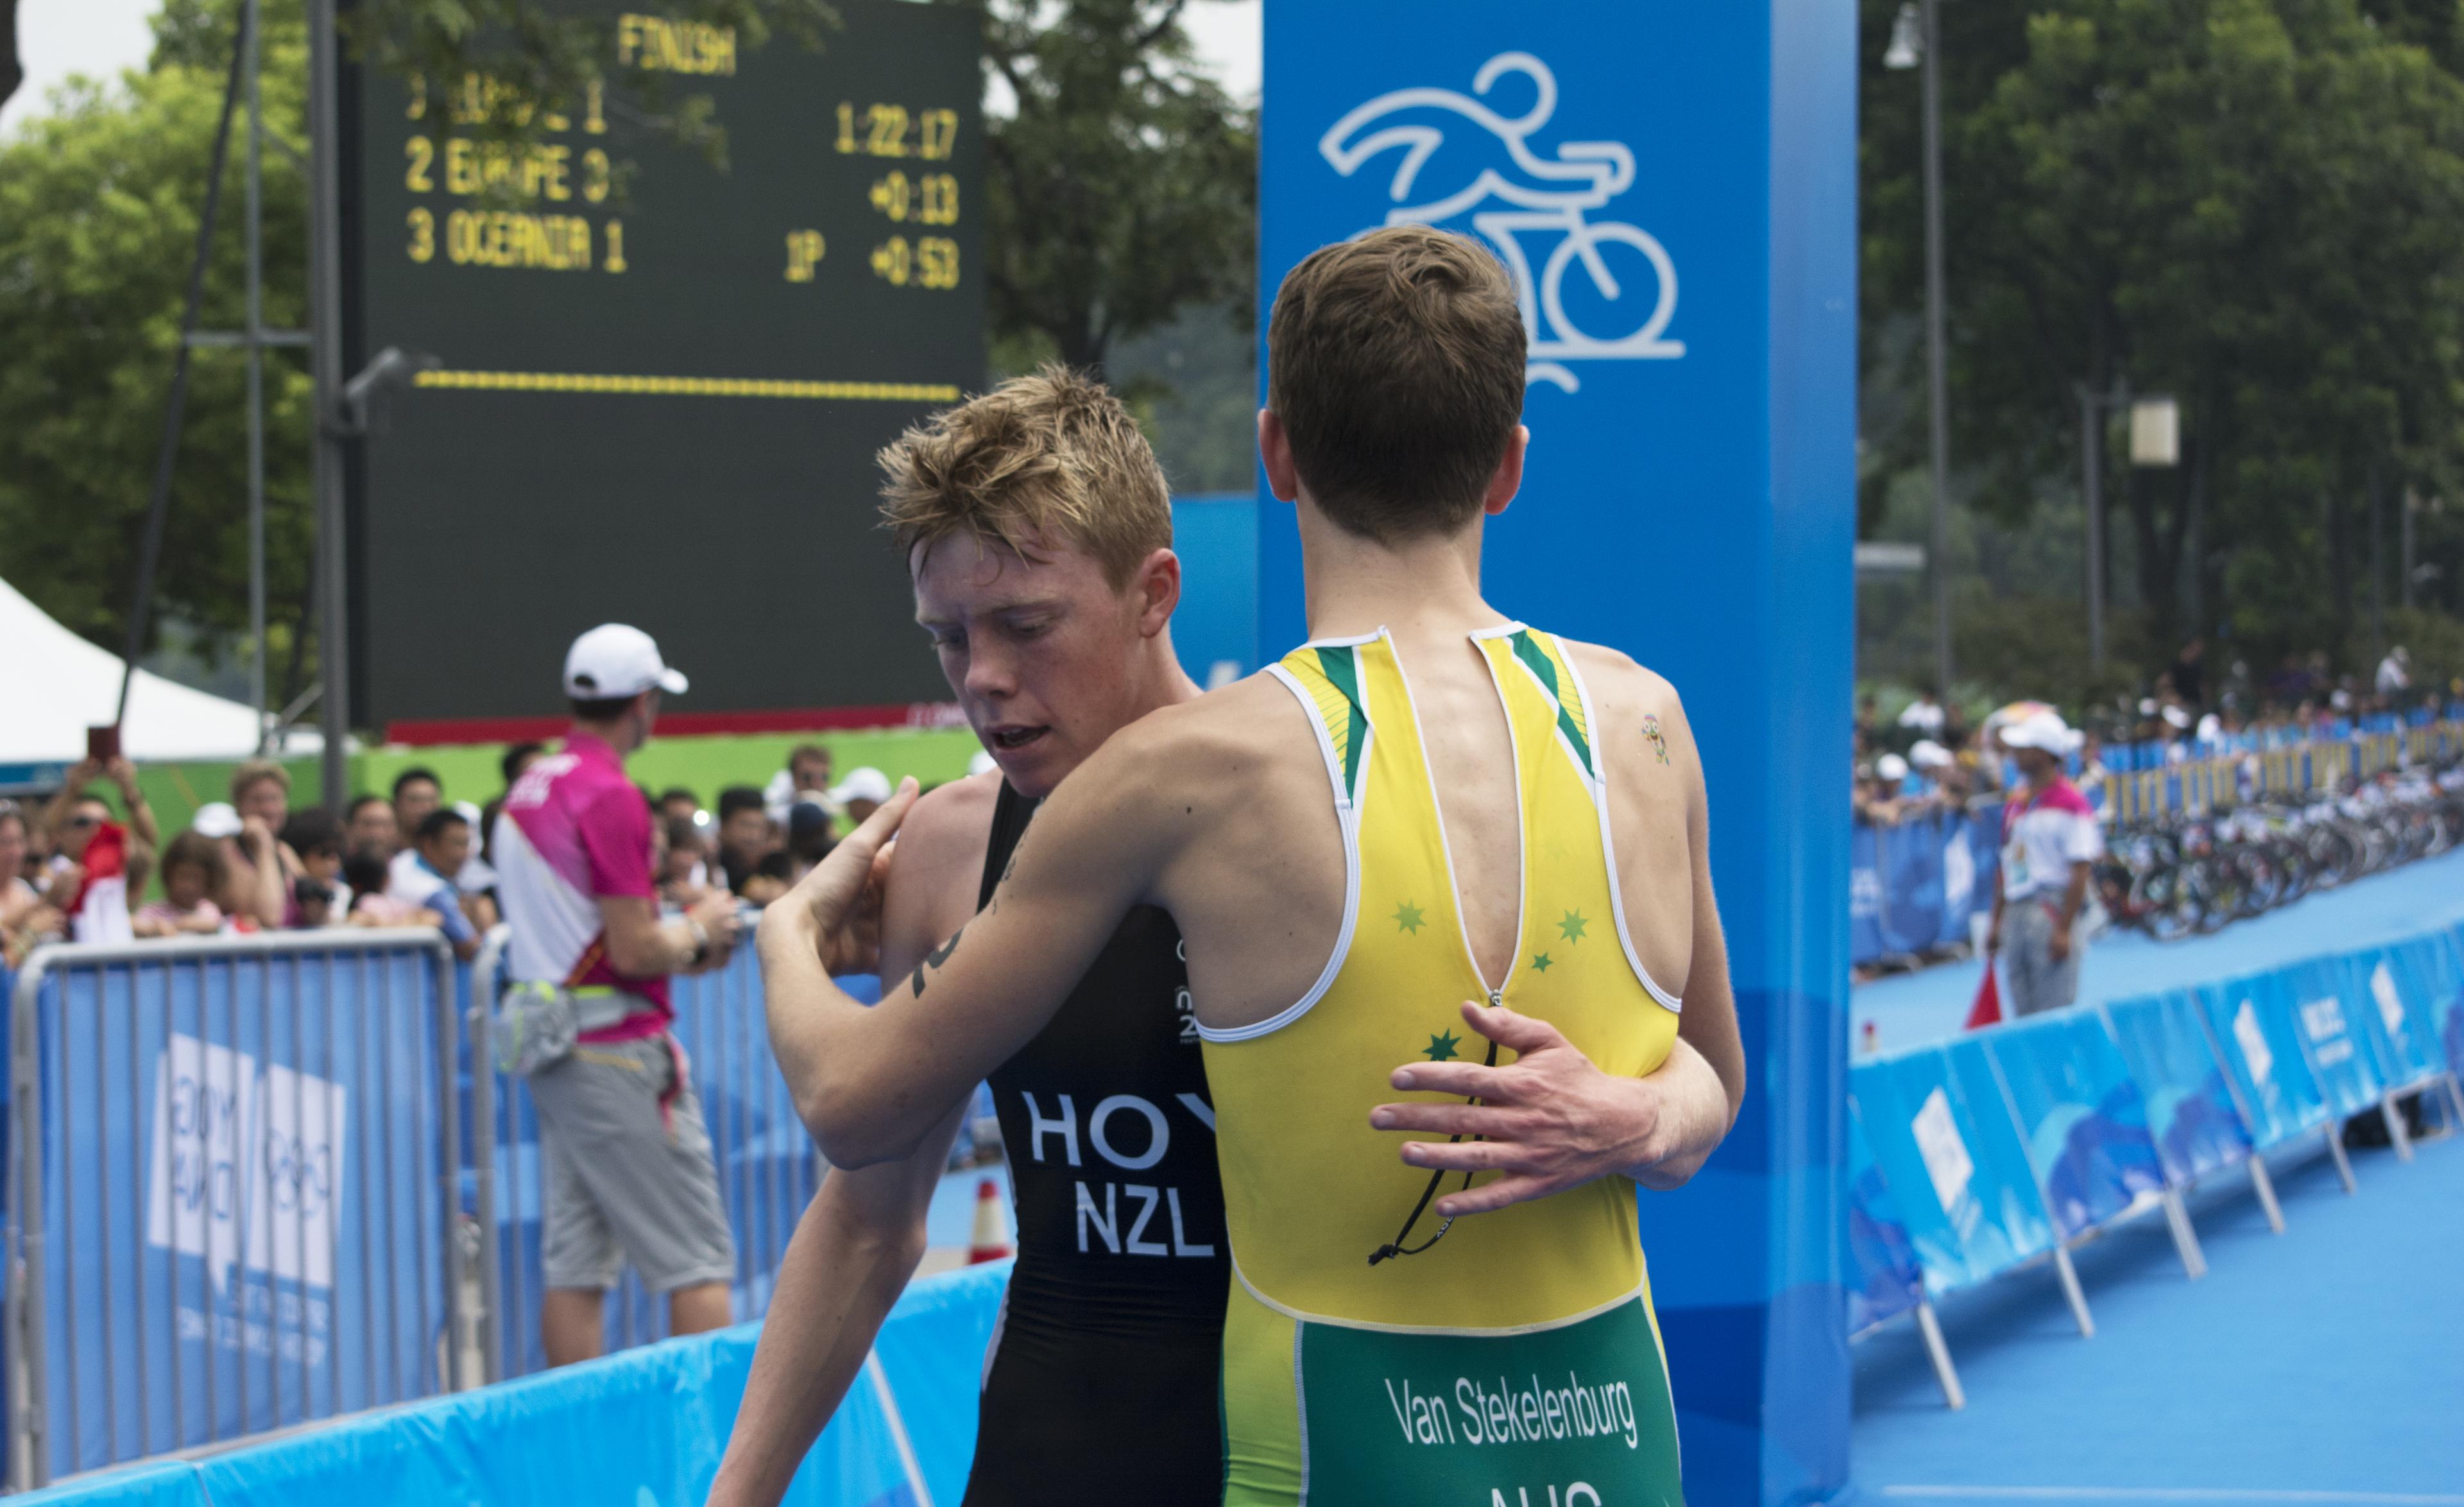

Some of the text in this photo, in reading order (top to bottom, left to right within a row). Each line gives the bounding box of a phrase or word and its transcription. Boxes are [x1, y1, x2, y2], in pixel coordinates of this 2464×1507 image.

[618, 13, 736, 76] FINISH
[835, 101, 959, 160] 1:22:17
[405, 135, 434, 192] 2
[869, 170, 959, 225] +0:13
[407, 207, 434, 264] 3
[446, 209, 591, 271] OCEANIA
[604, 219, 628, 273] 1
[870, 235, 960, 289] +0:53
[1075, 1180, 1215, 1257] NZL
[1384, 1370, 1638, 1449] Van Stekelenburg
